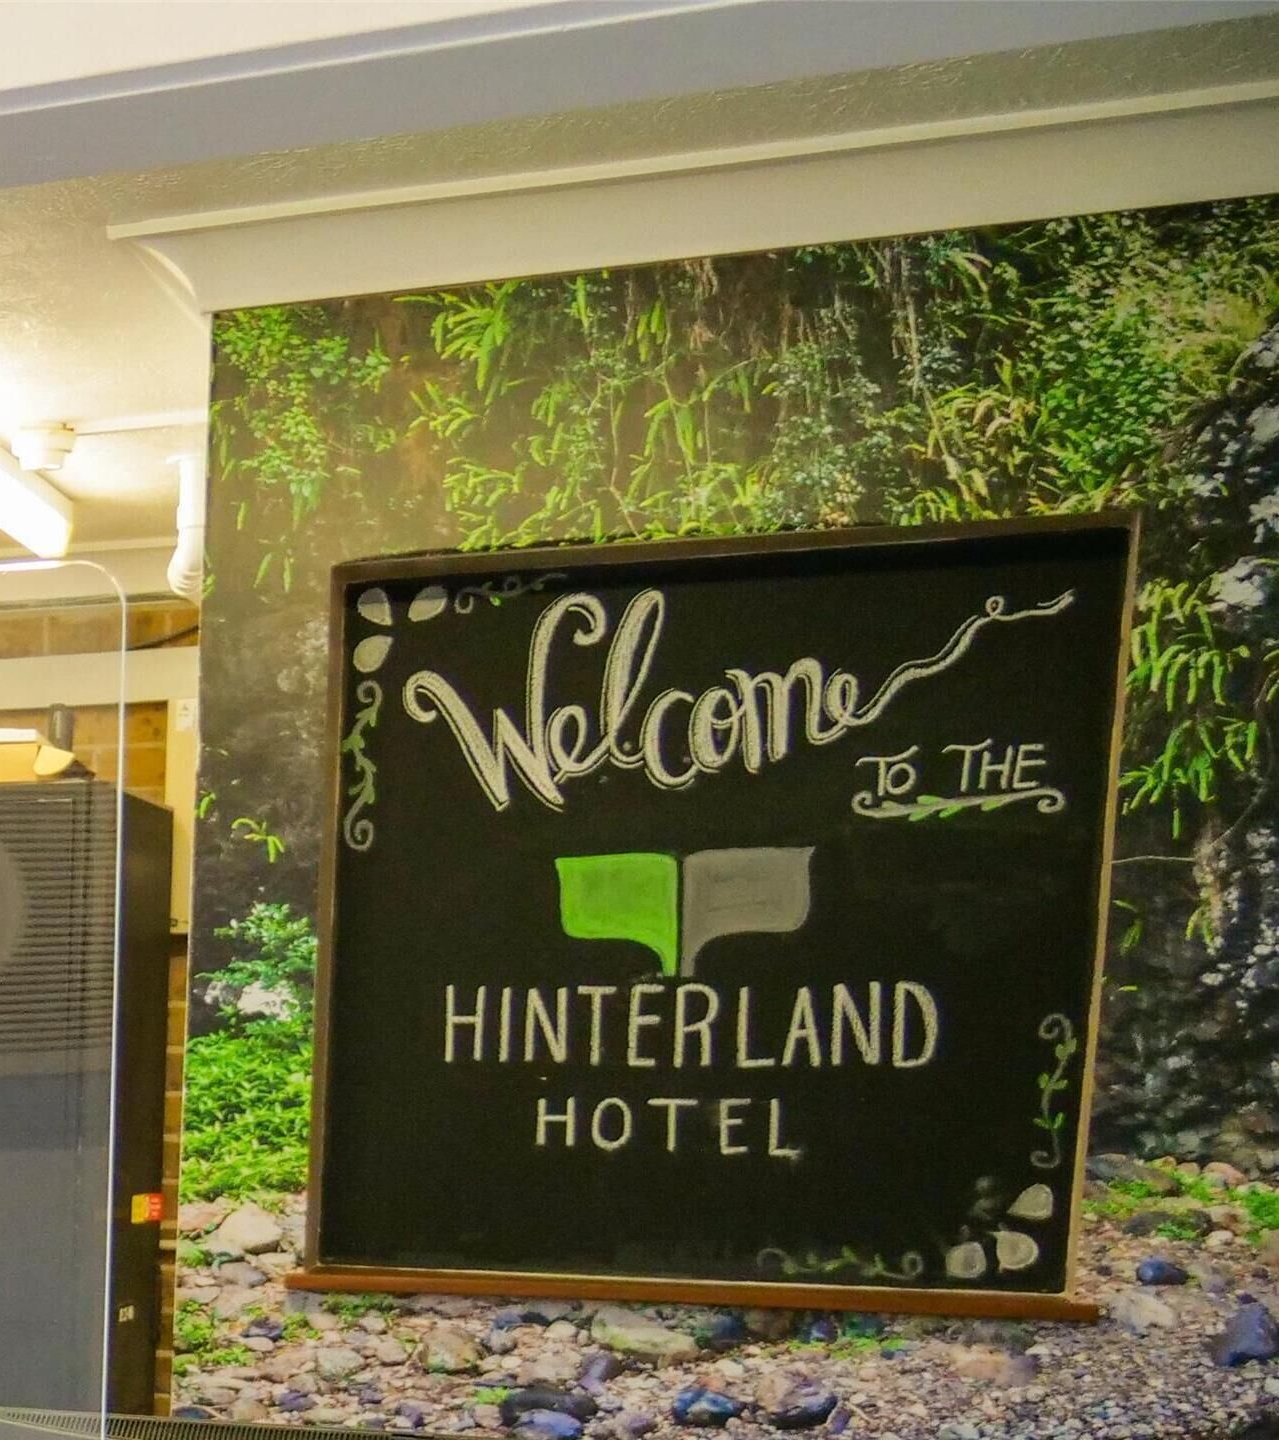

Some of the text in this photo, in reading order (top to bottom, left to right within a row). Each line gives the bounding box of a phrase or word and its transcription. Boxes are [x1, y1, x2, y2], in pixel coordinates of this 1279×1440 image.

[403, 588, 858, 811] Welcome
[857, 743, 1048, 797] TO THE
[444, 980, 939, 1070] HINTERLAND
[535, 1096, 802, 1160] HOTEL
